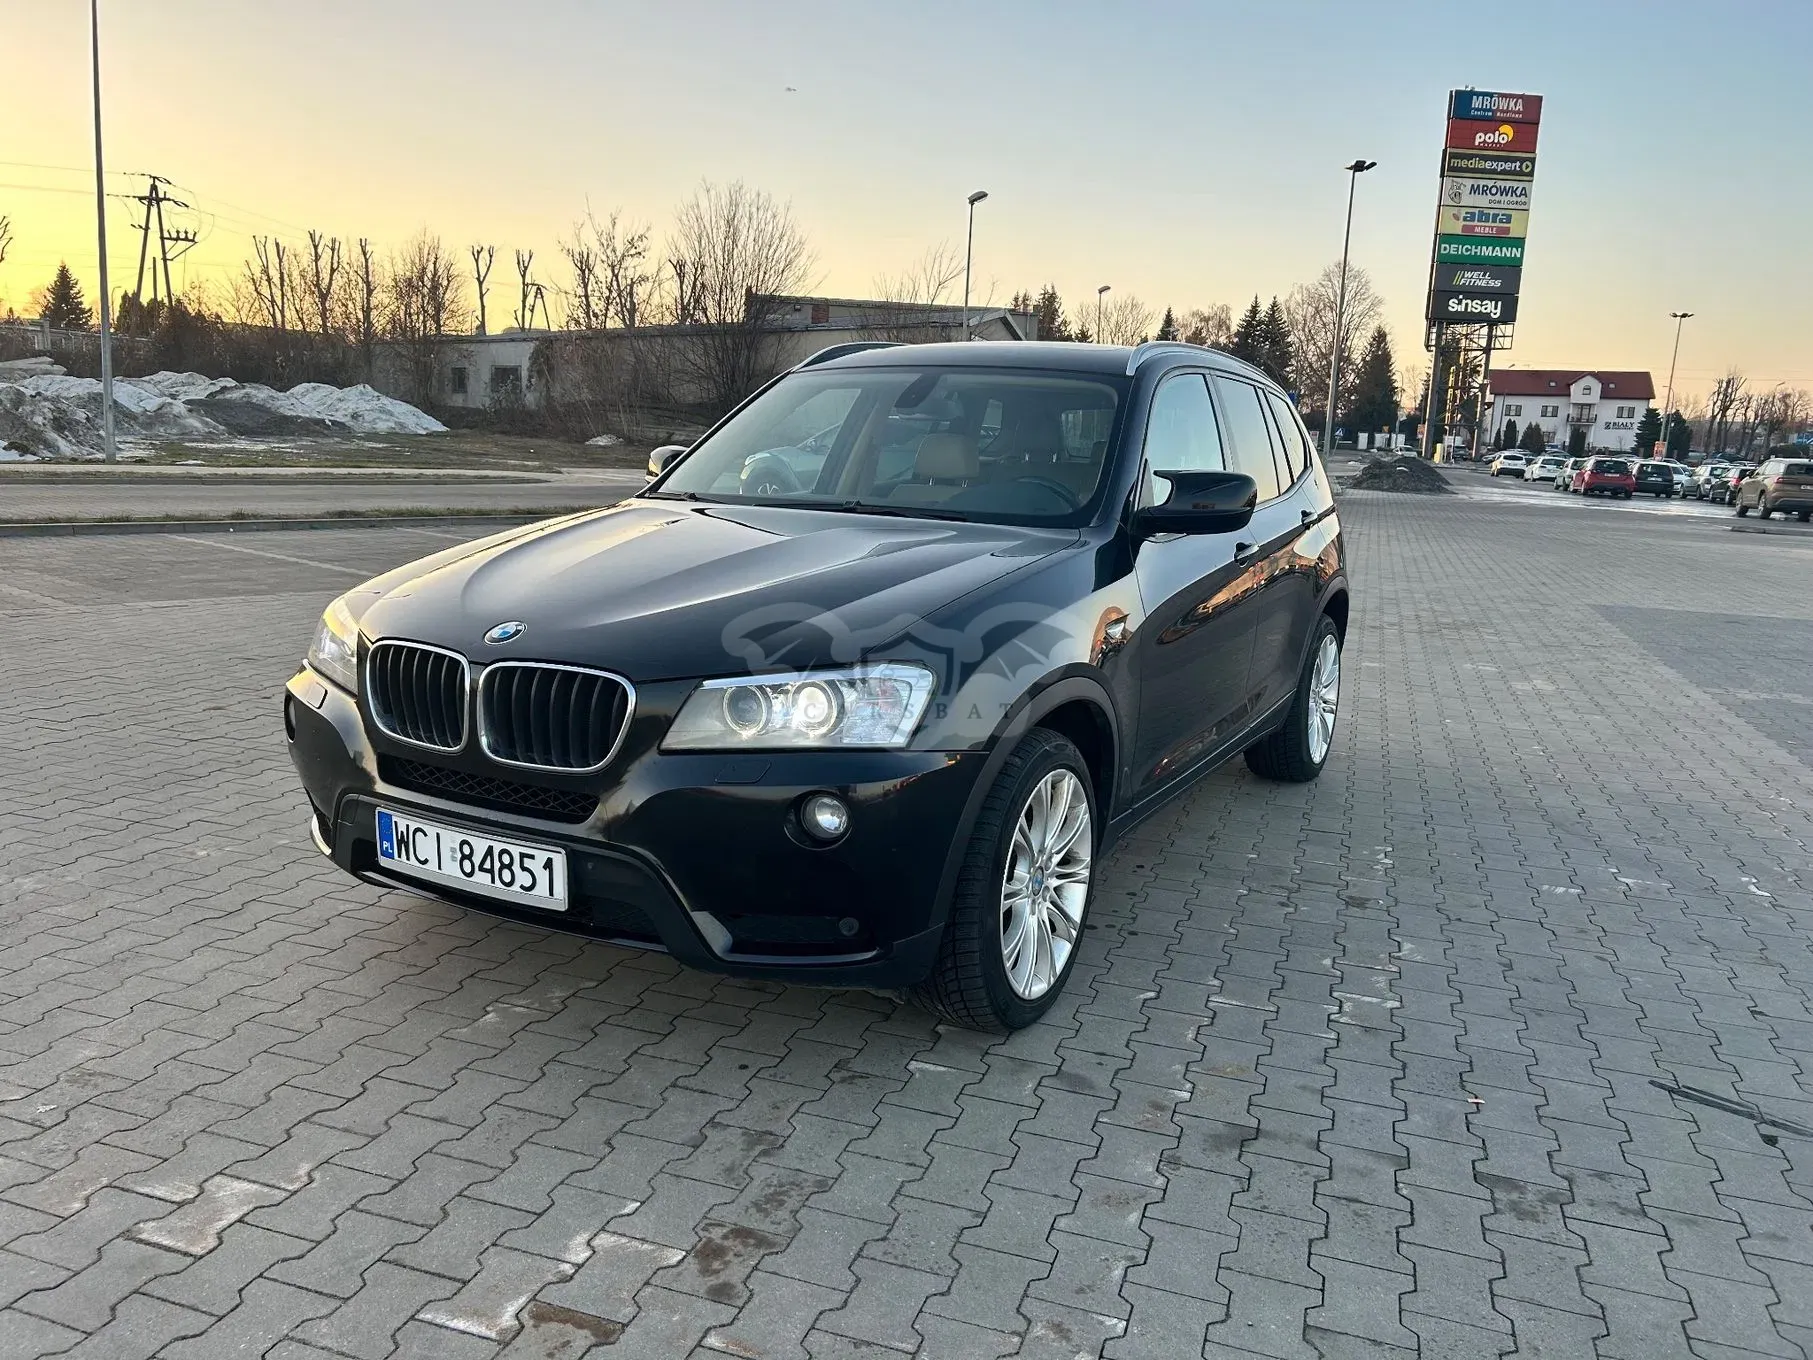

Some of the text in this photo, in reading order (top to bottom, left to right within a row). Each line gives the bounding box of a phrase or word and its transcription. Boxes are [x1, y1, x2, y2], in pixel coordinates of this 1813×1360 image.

[1471, 94, 1523, 111] MRÓWKA
[1475, 131, 1508, 146] polo
[1450, 157, 1521, 171] mediaexpert
[1469, 180, 1528, 198] MRÓWKA
[1463, 209, 1512, 224] abra
[1474, 225, 1497, 234] MEBLE
[1440, 243, 1522, 258] DEICHMANN
[1460, 278, 1502, 287] FITNESS
[1464, 271, 1491, 279] WELL
[1448, 294, 1502, 318] sinsay
[383, 840, 392, 853] PL
[394, 820, 554, 897] WCI 84851
